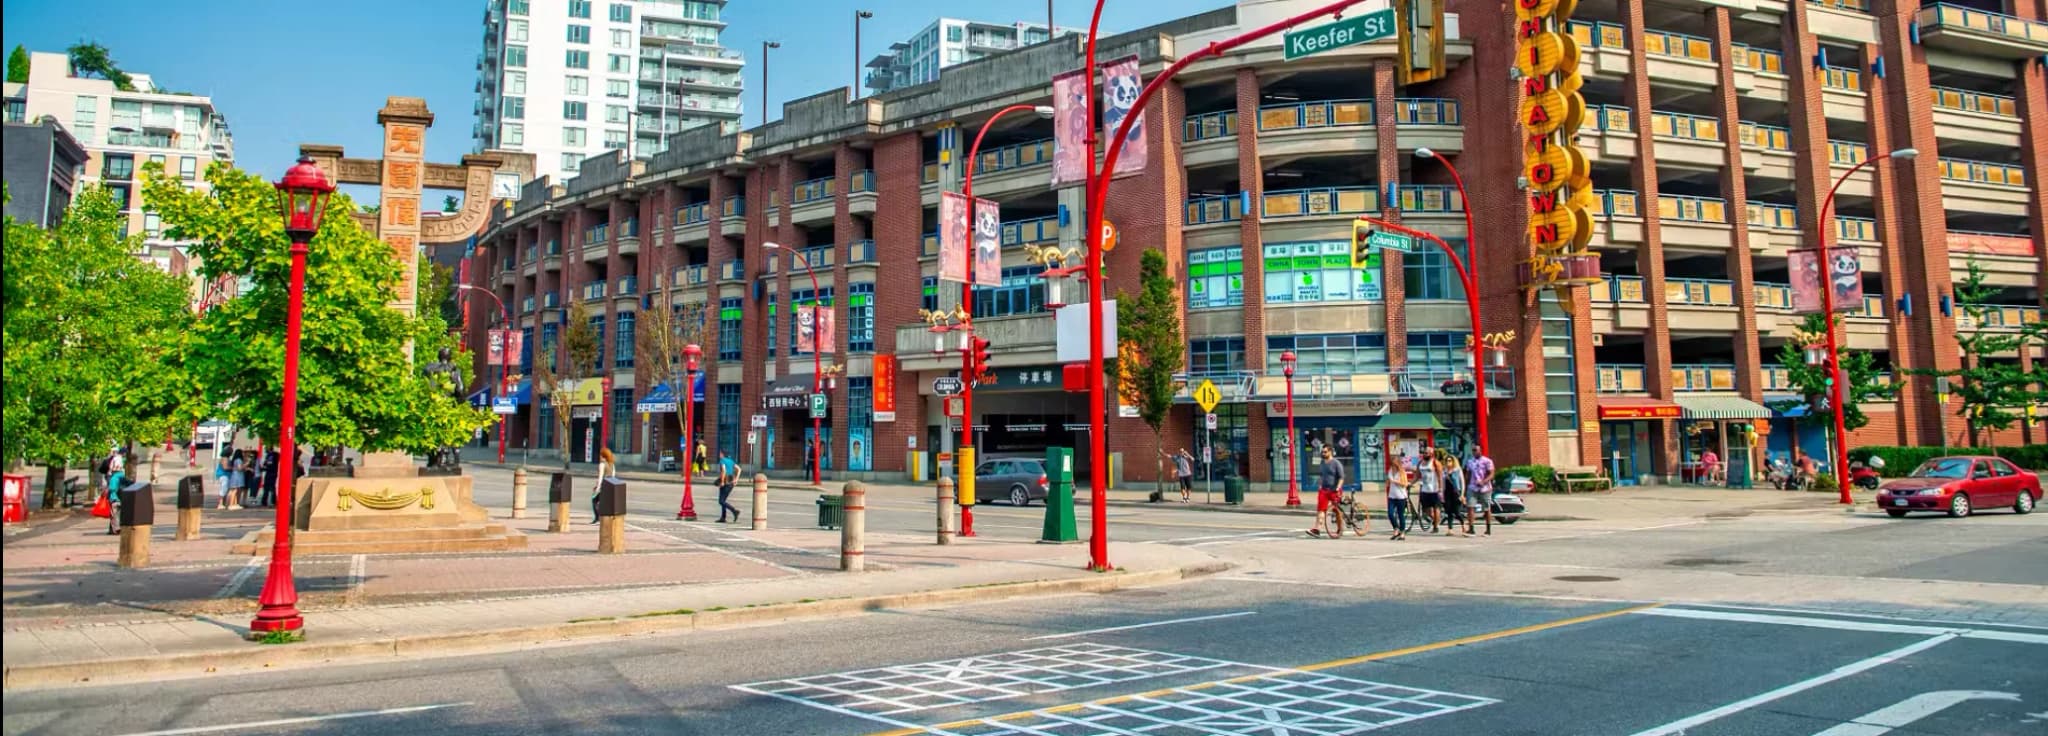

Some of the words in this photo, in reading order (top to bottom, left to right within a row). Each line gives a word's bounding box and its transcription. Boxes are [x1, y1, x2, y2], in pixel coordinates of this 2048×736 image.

[1293, 27, 1355, 54] Keefer
[1364, 16, 1386, 37] St
[1102, 225, 1113, 245] P
[1372, 234, 1399, 248] Columbia
[1400, 238, 1408, 249] St
[1019, 370, 1053, 384] 停車場
[814, 397, 823, 409] P
